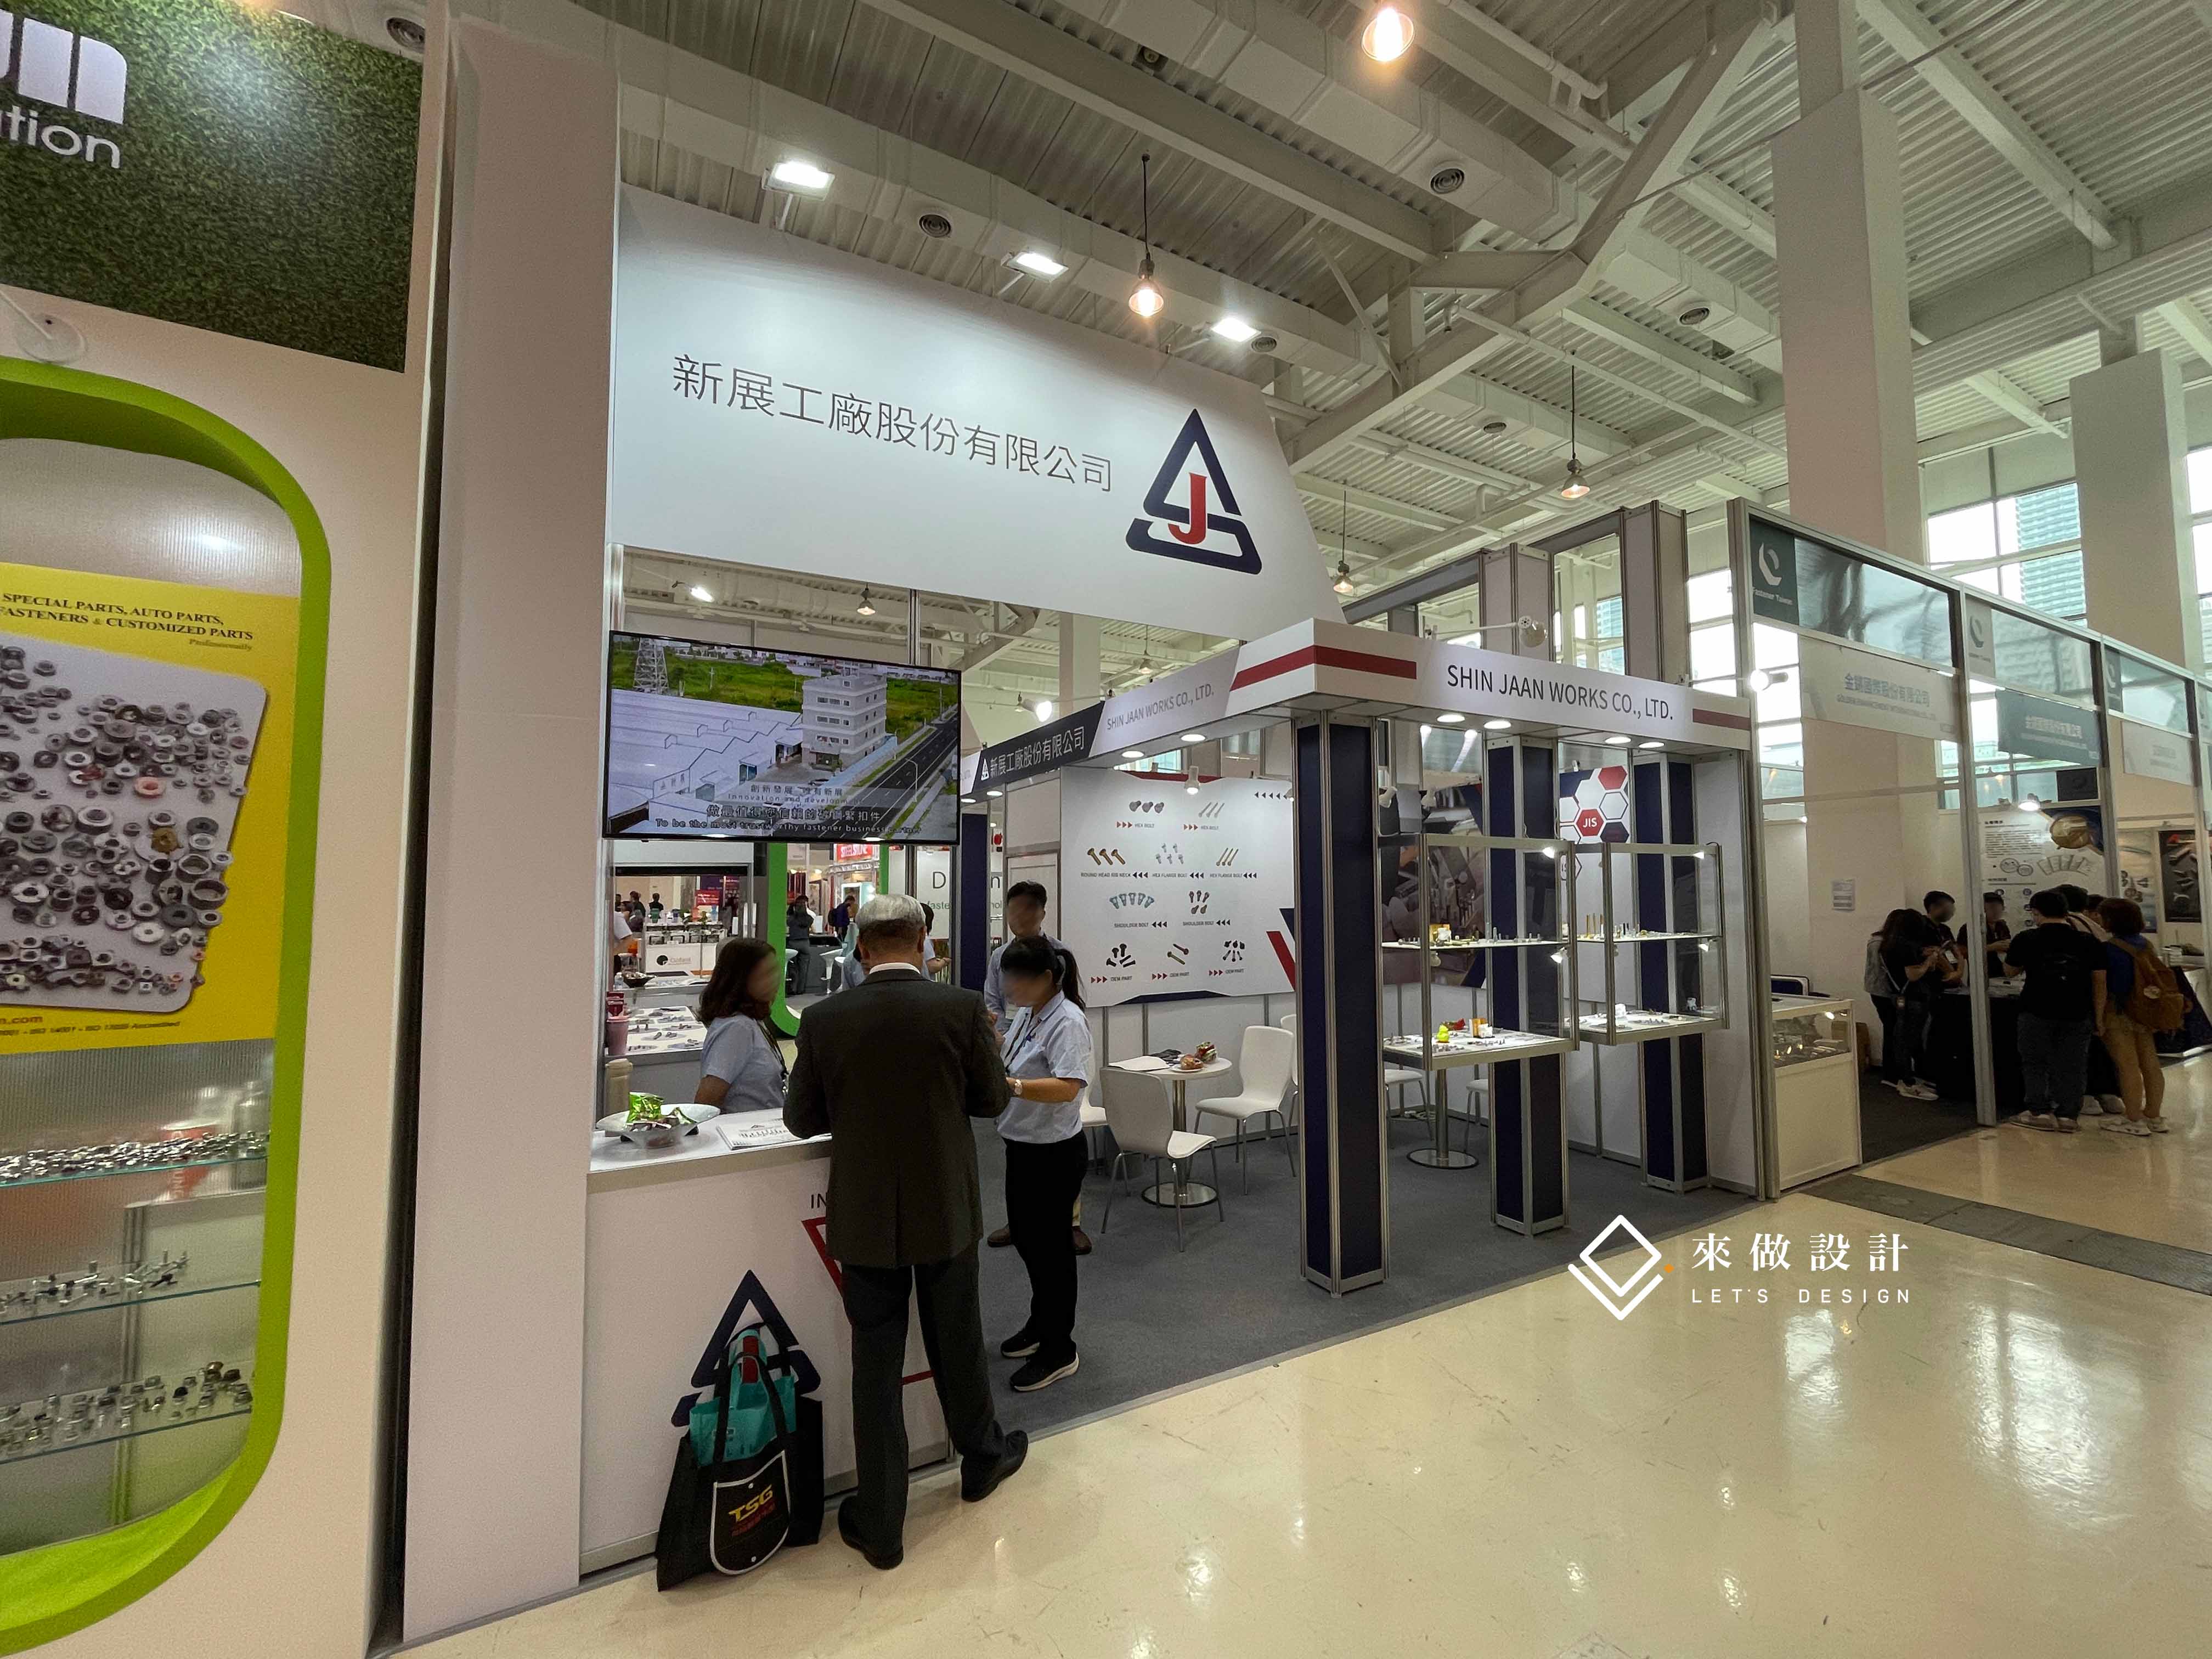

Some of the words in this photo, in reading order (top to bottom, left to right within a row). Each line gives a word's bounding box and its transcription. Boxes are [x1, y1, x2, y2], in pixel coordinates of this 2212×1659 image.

[673, 353, 1113, 493] 新展工廠股份有限公司
[3, 592, 72, 609] SPECIAL
[132, 607, 172, 619] AUTO
[106, 617, 206, 635] CUSTOMIZED
[210, 628, 253, 641] PARTS
[1447, 664, 1493, 692] SHIN
[1499, 674, 1544, 700] JAAN
[1549, 681, 1608, 710] WORKS
[1612, 692, 1641, 719] CO.,
[1645, 697, 1673, 720] LTD.
[1107, 714, 1124, 730] SHIN
[1125, 708, 1144, 724] JAAN
[1146, 696, 1175, 716] WORKS
[1176, 692, 1194, 707] CO.,
[1195, 684, 1215, 701] LTD.
[990, 726, 1085, 779] 新展工廠股份有限公司
[728, 793, 780, 802] Innovation
[656, 818, 668, 828] To
[672, 818, 686, 827] be
[689, 819, 708, 828] the
[711, 820, 737, 829] most
[740, 821, 799, 832] trustworthy
[803, 823, 842, 832] fastener
[846, 825, 884, 833] business
[1583, 817, 1598, 828] JIS
